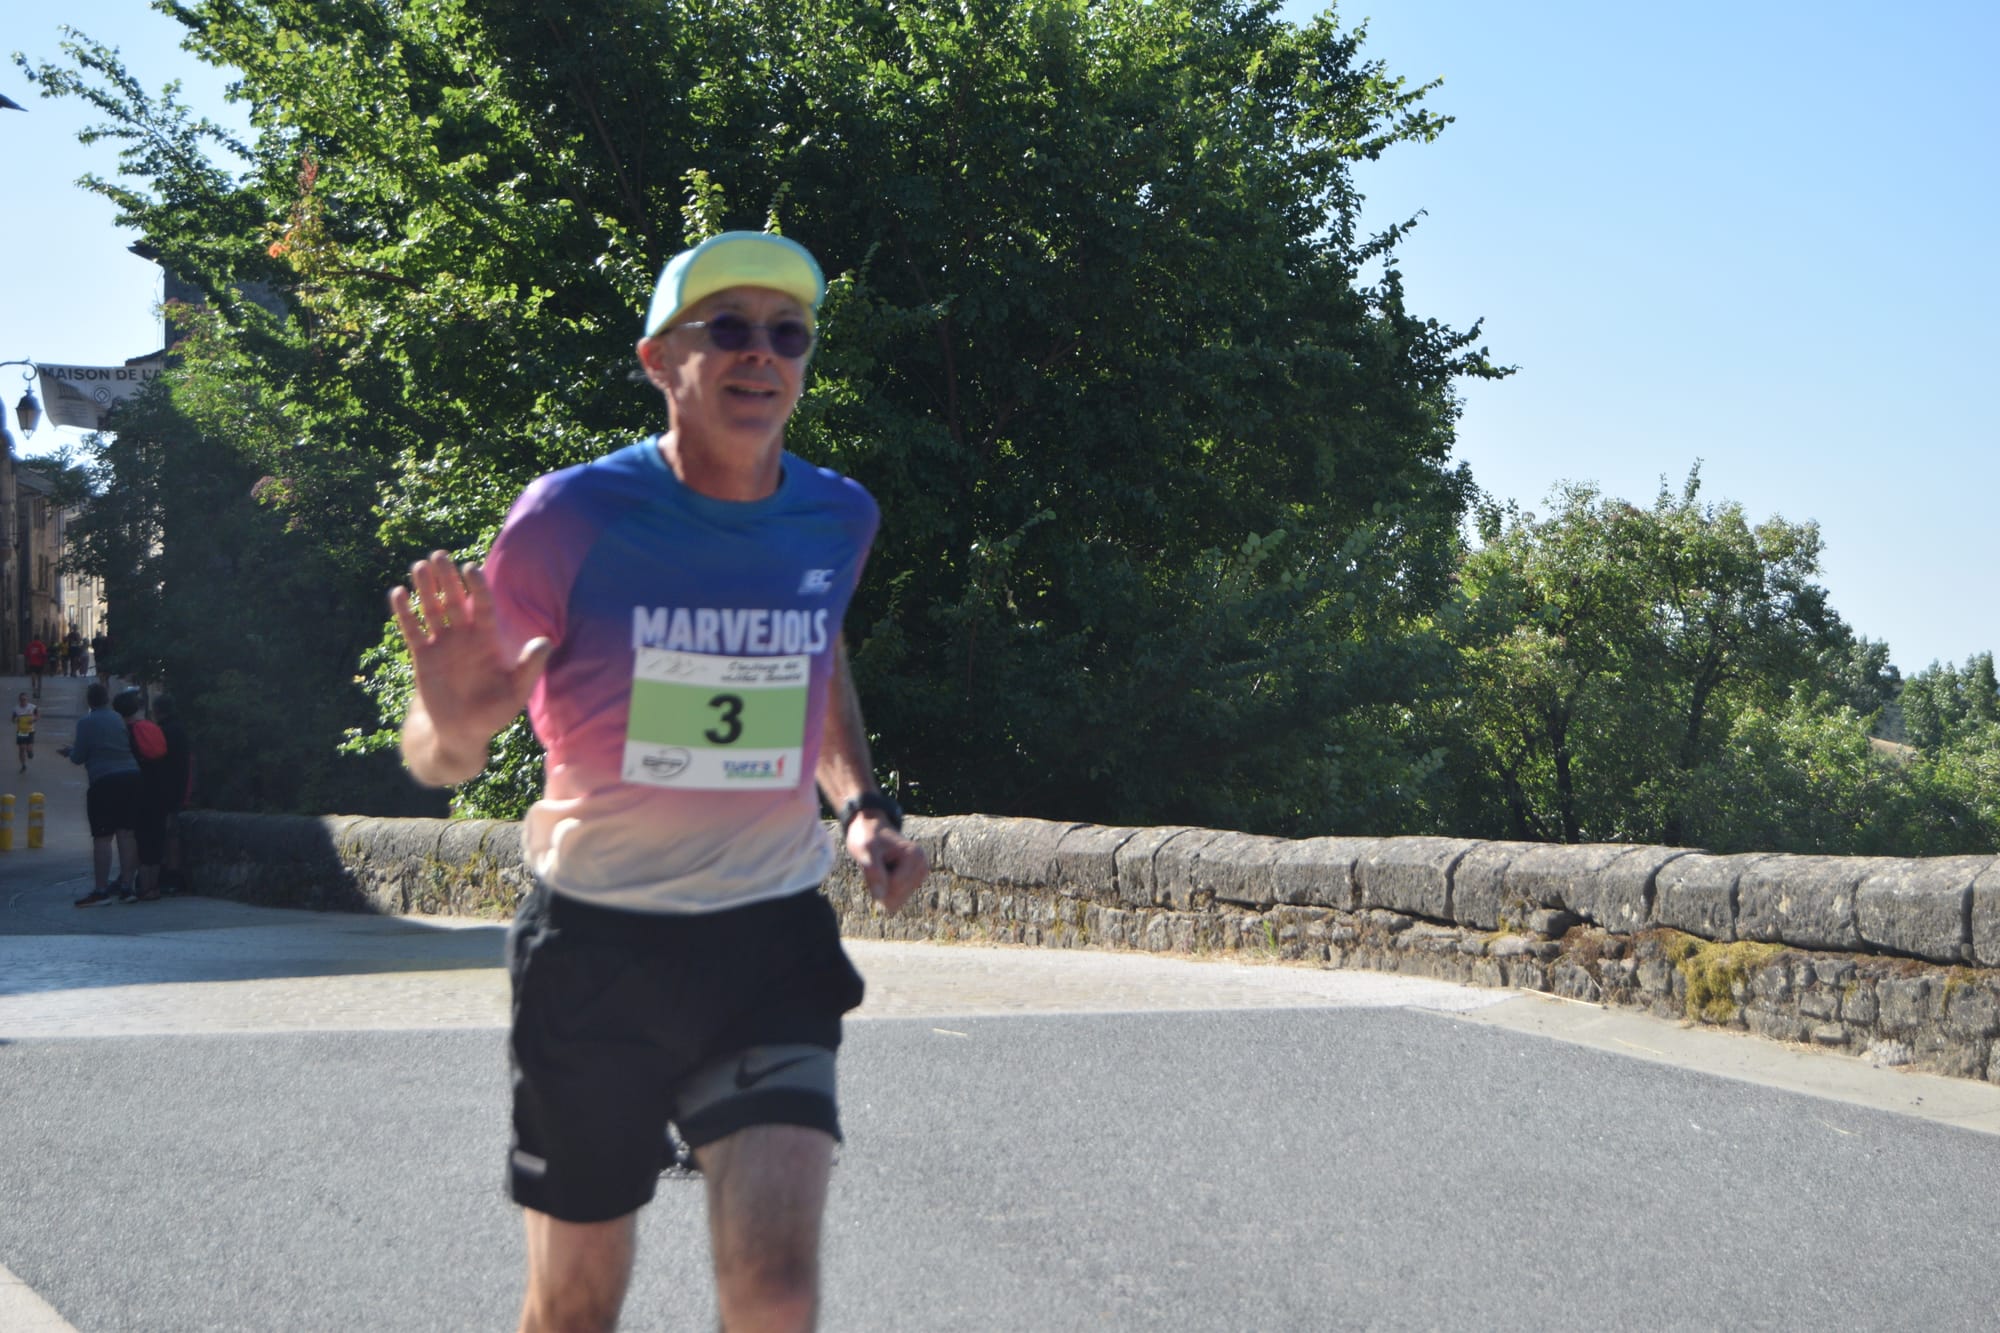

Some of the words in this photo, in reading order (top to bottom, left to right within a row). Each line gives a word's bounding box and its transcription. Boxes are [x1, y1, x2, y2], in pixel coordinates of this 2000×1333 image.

[42, 367, 110, 381] MAISON
[115, 368, 138, 381] DE
[632, 605, 828, 656] MARVEJOLS
[704, 693, 745, 745] 3
